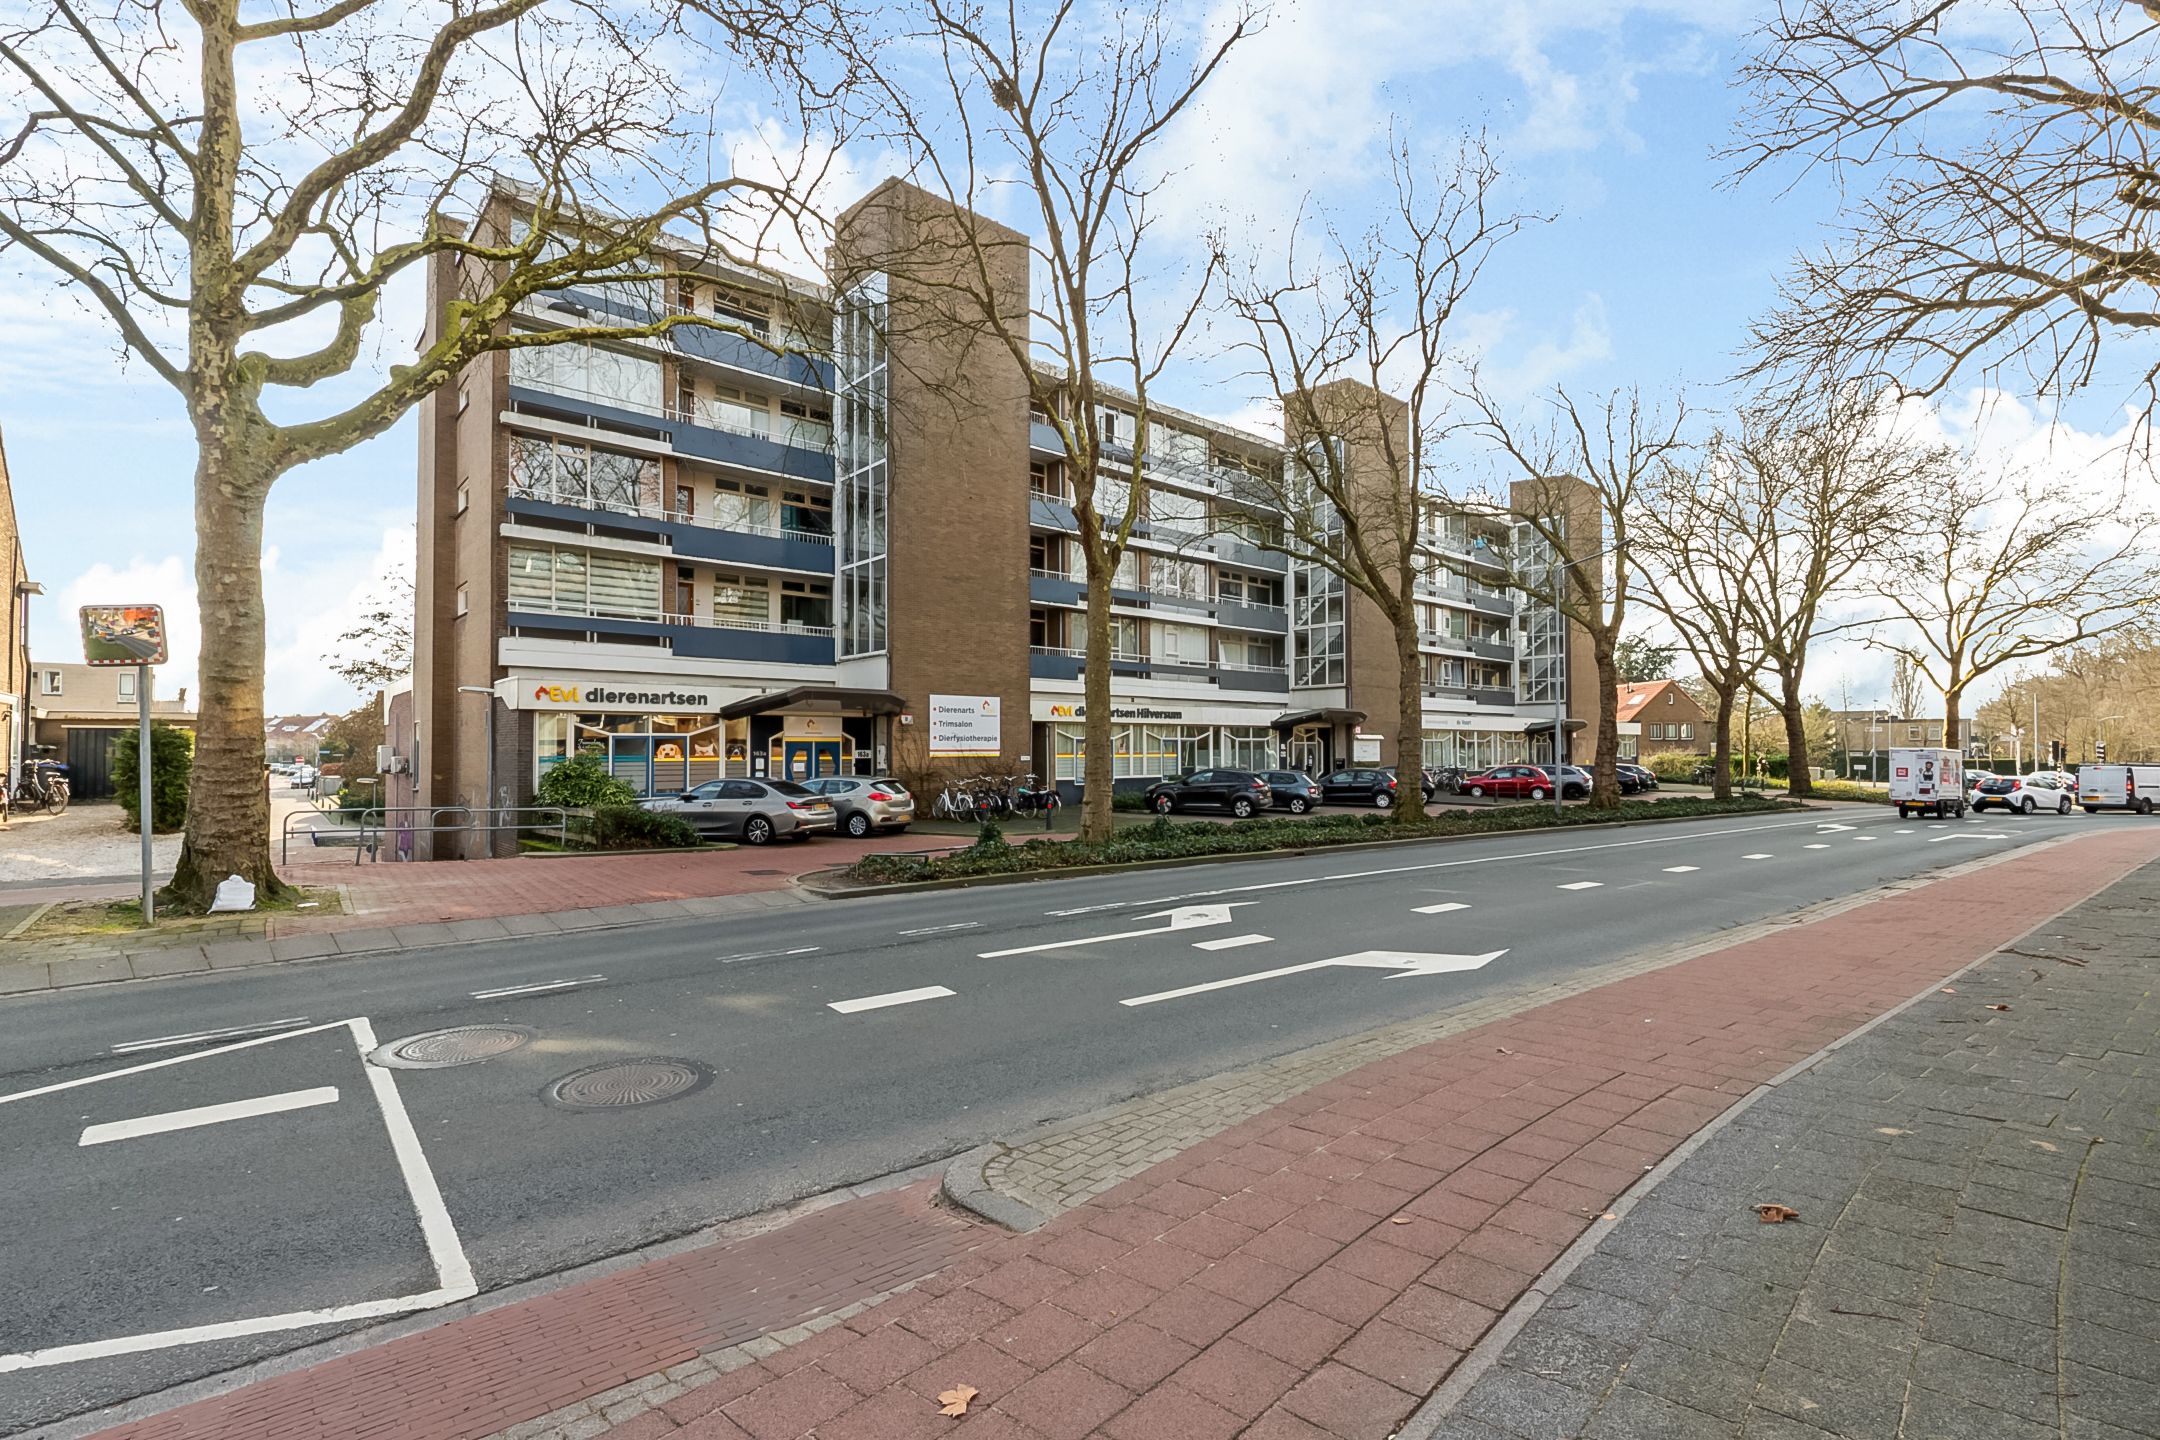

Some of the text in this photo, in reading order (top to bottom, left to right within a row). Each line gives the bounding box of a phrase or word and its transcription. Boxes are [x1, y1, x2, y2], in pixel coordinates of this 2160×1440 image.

[549, 685, 708, 706] Evi dierenartsen
[938, 706, 975, 714] Dierenarts
[1137, 708, 1182, 719] Hilversum
[938, 720, 973, 728] Trimsalon
[938, 734, 998, 743] Dierfysiotherapie
